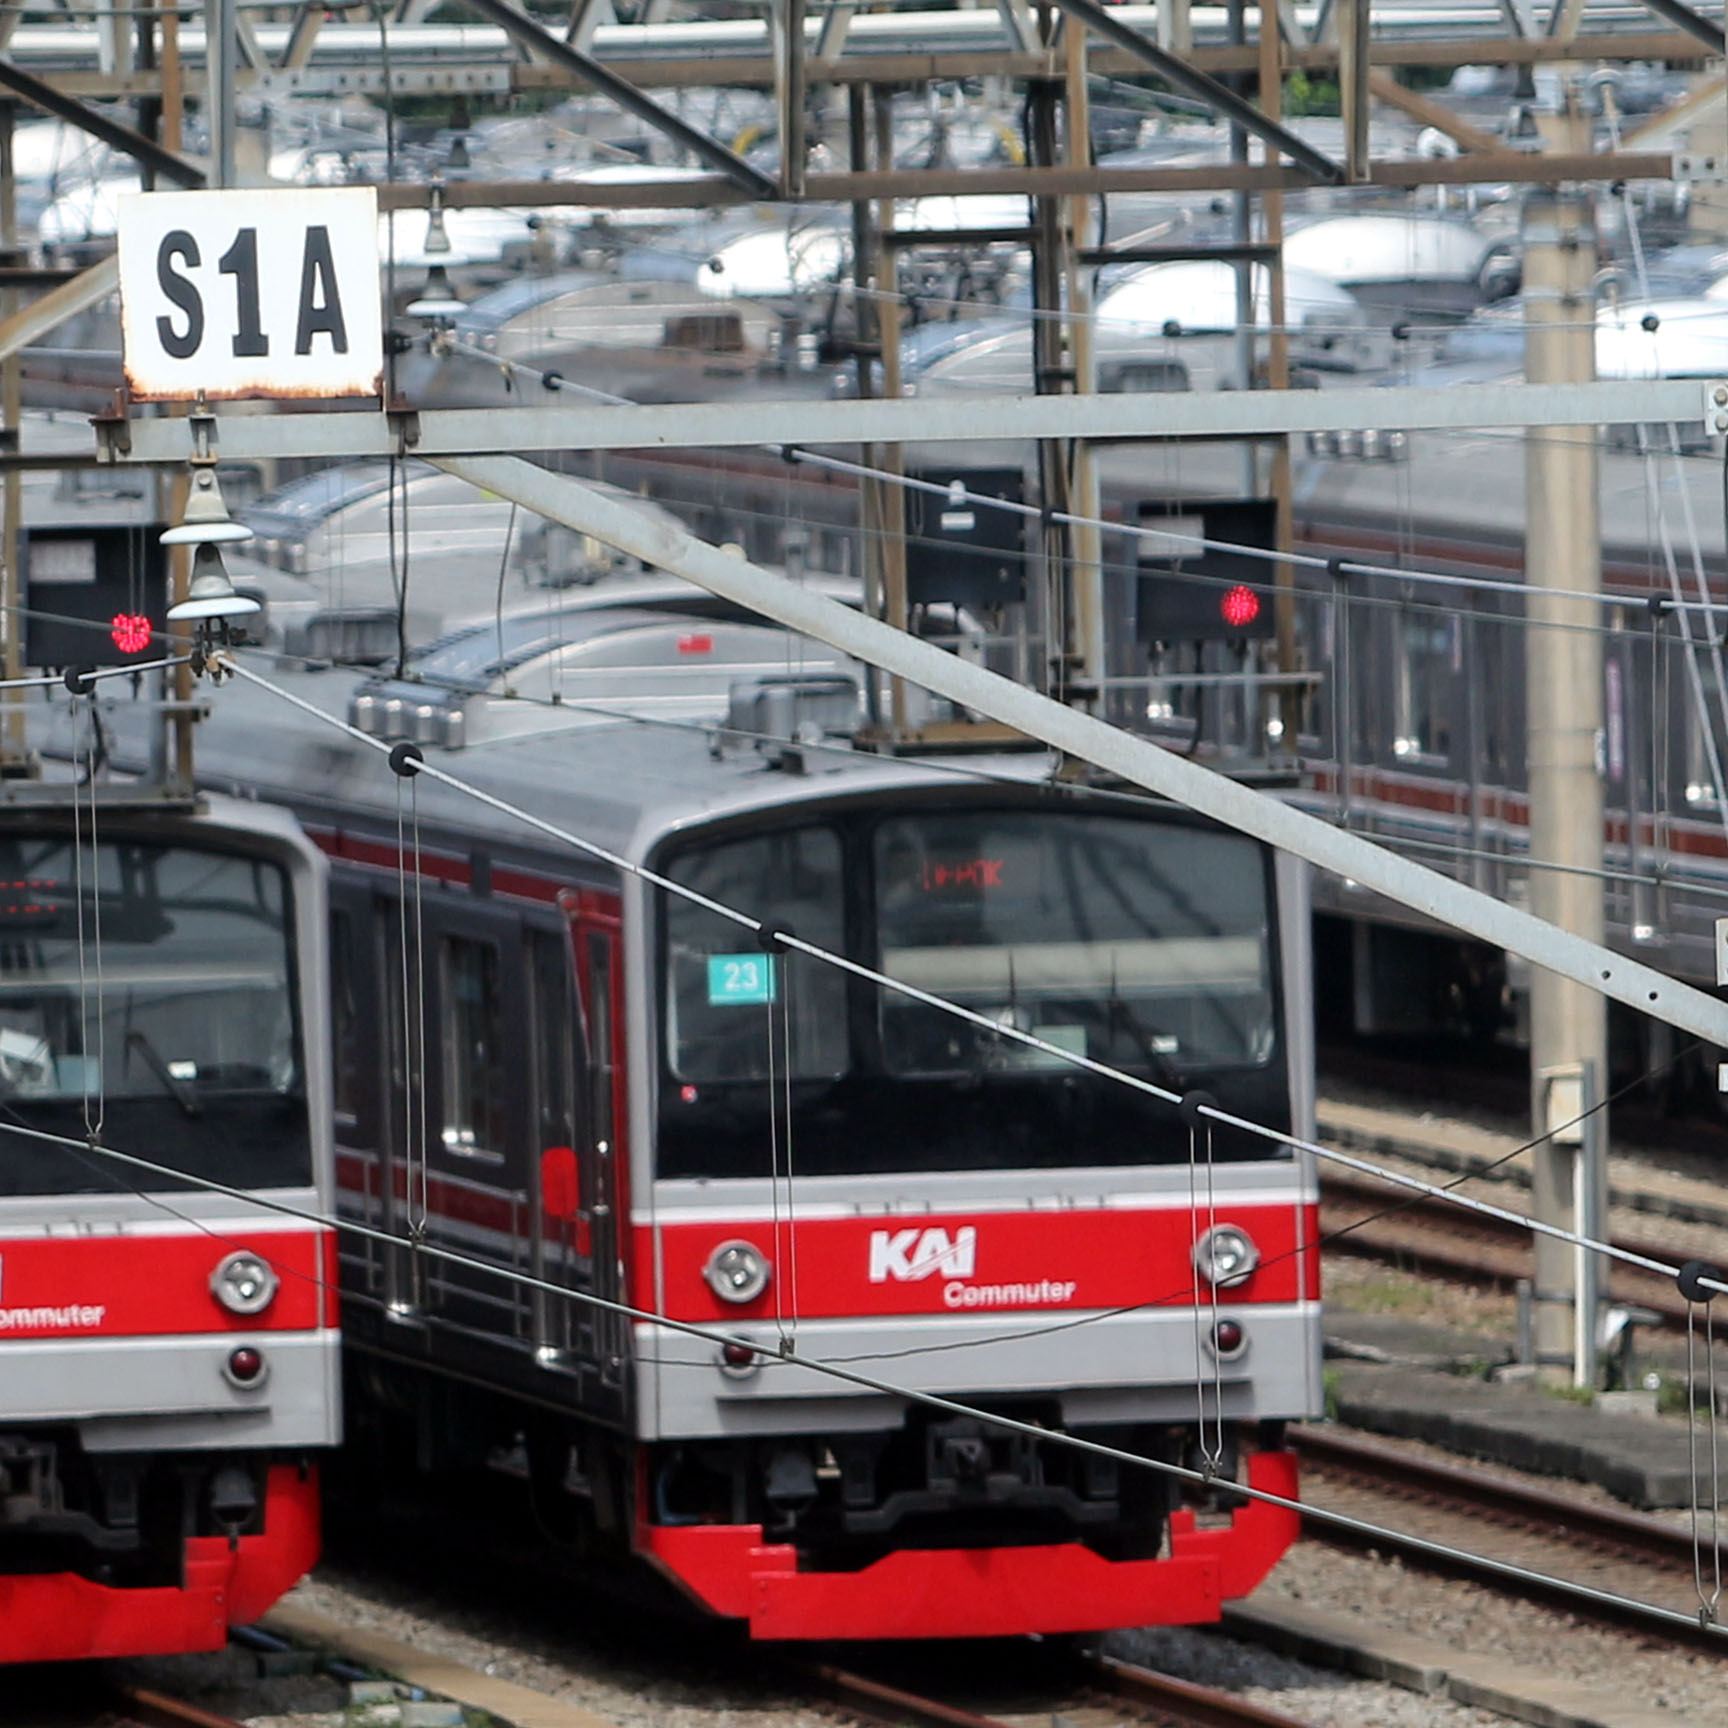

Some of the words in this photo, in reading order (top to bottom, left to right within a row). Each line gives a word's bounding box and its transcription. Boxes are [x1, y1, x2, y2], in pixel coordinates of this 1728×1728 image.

[156, 225, 349, 359] S1A
[724, 961, 759, 992] 23
[869, 1226, 977, 1283] KAI
[943, 1278, 1076, 1308] Commuter
